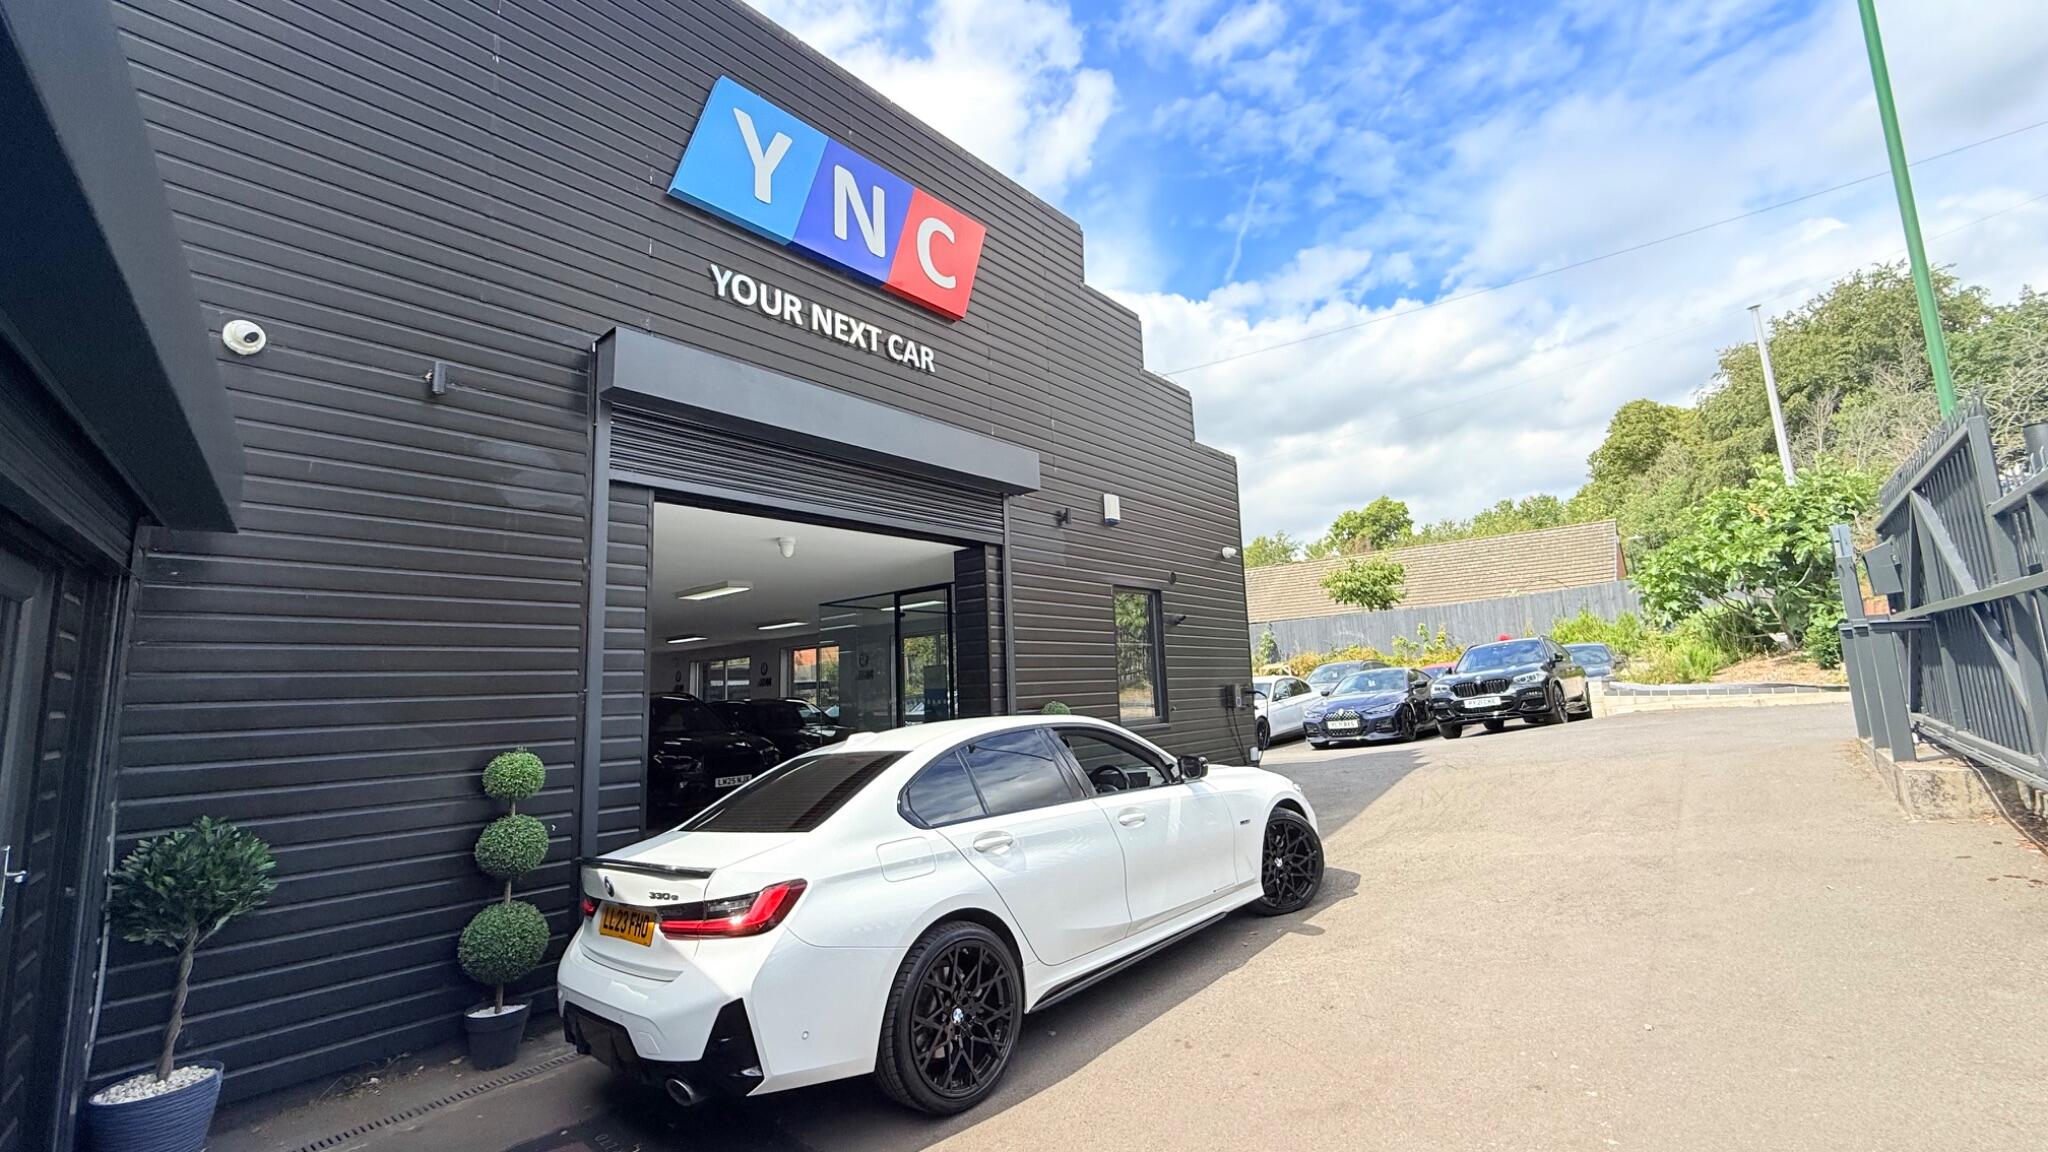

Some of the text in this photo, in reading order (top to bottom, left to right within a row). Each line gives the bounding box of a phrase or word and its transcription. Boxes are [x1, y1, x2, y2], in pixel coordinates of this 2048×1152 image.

[733, 107, 957, 289] YNC
[710, 263, 936, 373] YOUR NEXT CAR
[603, 906, 628, 933] LL23
[648, 892, 679, 901] 330e
